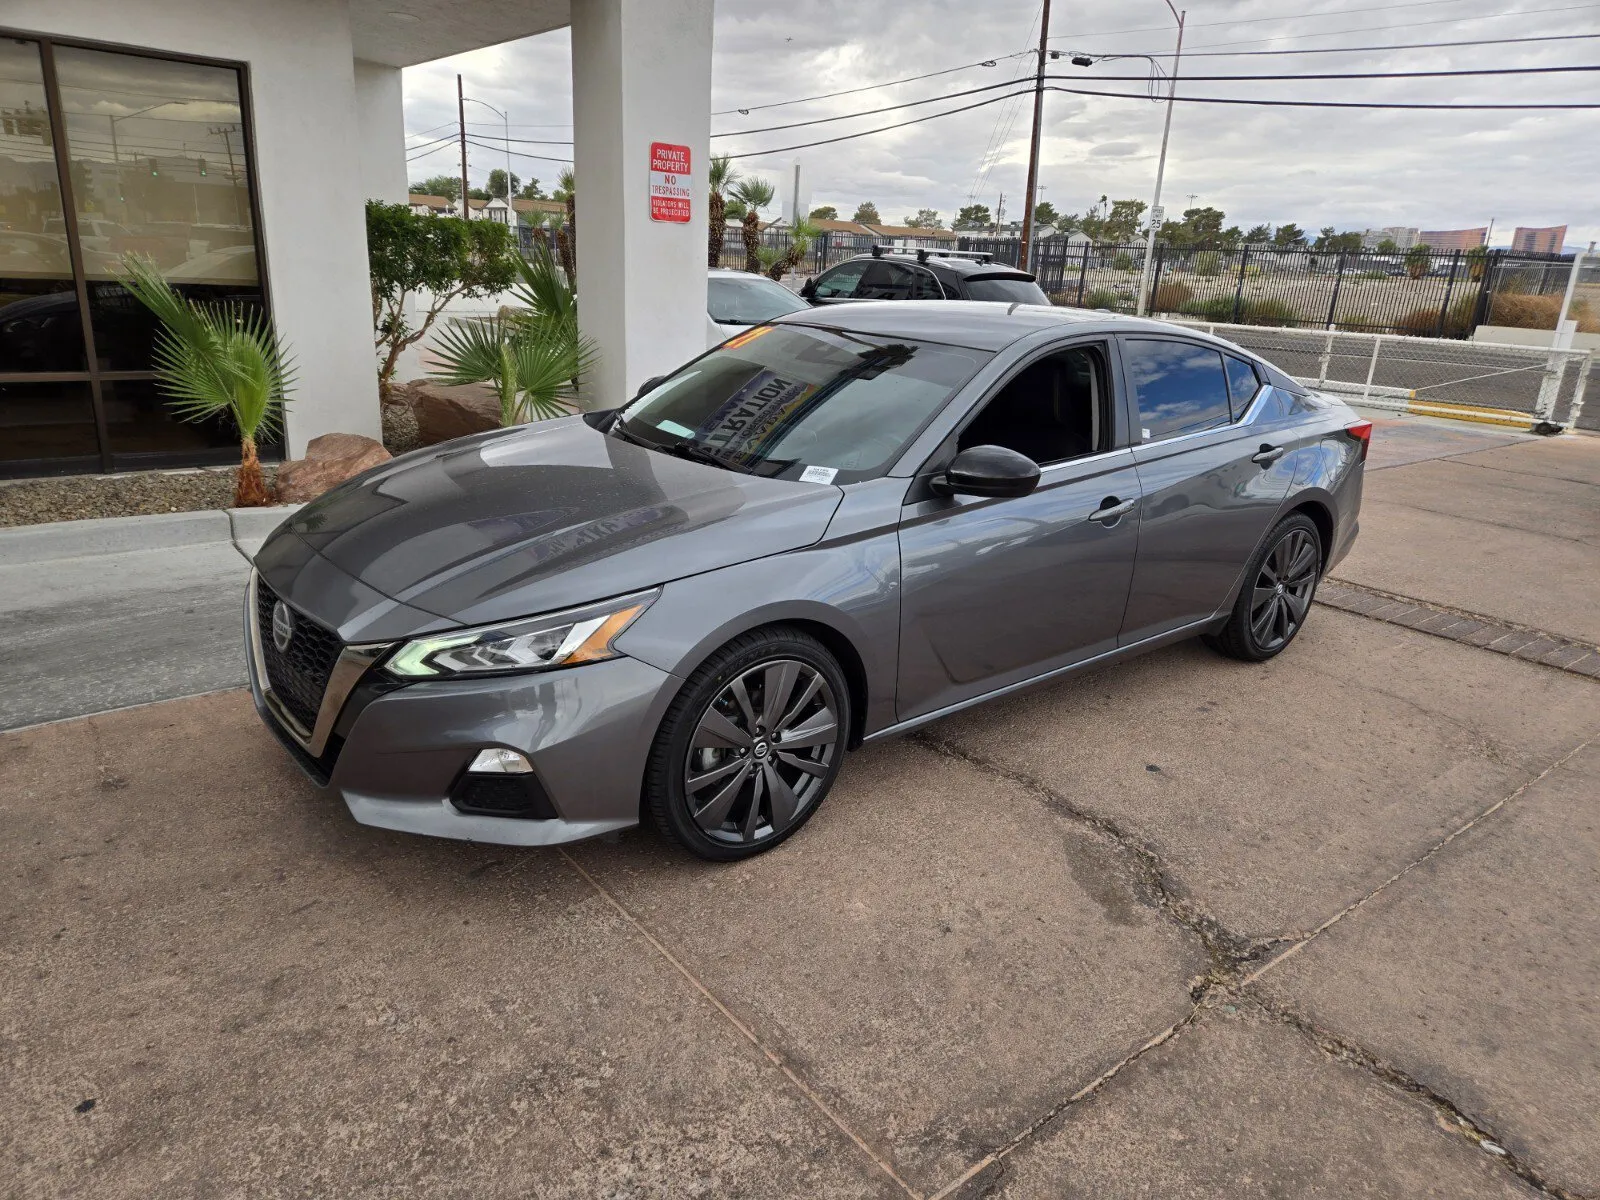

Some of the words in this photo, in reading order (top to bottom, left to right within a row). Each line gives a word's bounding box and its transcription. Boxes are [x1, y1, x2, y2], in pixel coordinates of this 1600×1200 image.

[657, 149, 685, 161] PRIVATE
[653, 160, 689, 172] PROPERTY
[664, 174, 677, 185] NO
[652, 185, 690, 197] TRESPASSING
[653, 199, 677, 208] VIOLATORS
[678, 201, 689, 209] WILL
[660, 208, 689, 216] PROSECUTED
[1151, 219, 1161, 228] 25
